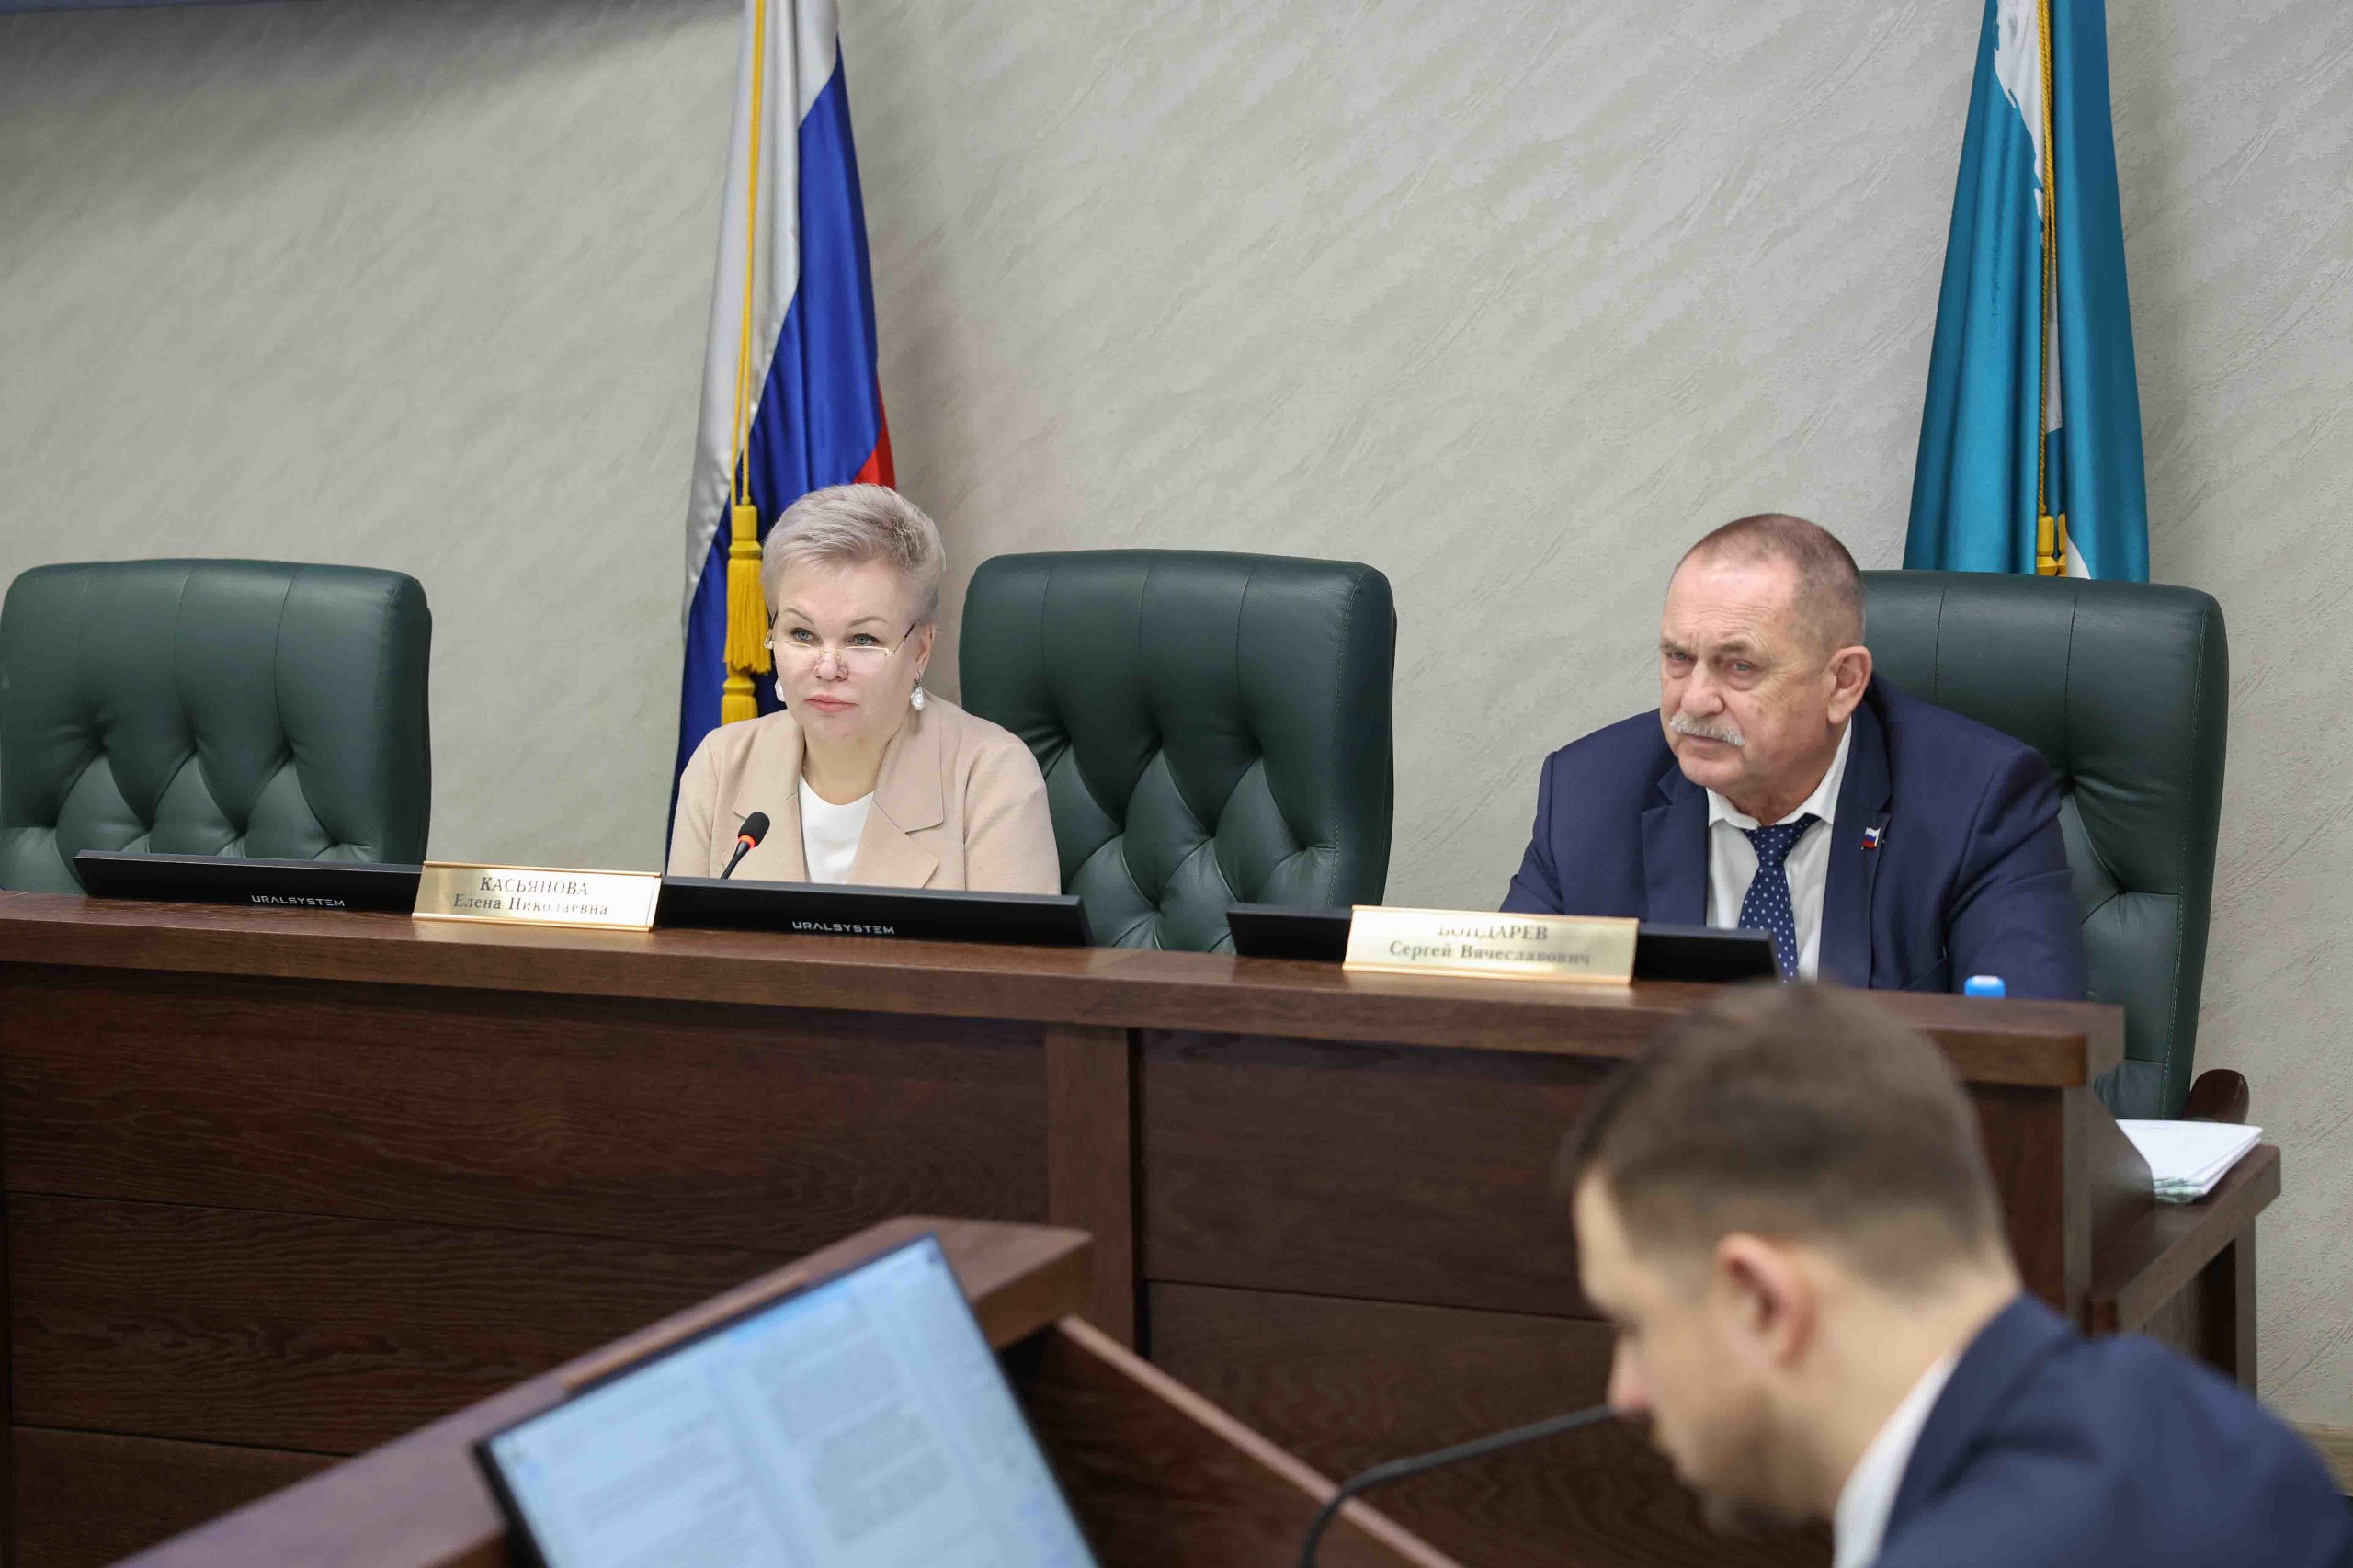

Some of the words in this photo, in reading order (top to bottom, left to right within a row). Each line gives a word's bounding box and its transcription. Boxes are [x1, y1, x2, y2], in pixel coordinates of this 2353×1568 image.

[479, 876, 588, 896] КАСЬЯНОВА
[251, 894, 346, 907] URALSYSTEM
[453, 893, 502, 910] Елена
[508, 896, 608, 915] Николаевна
[791, 920, 895, 935] URALSYSTEM
[1389, 939, 1453, 960] Сергей
[1460, 943, 1591, 966] Вячеславович
